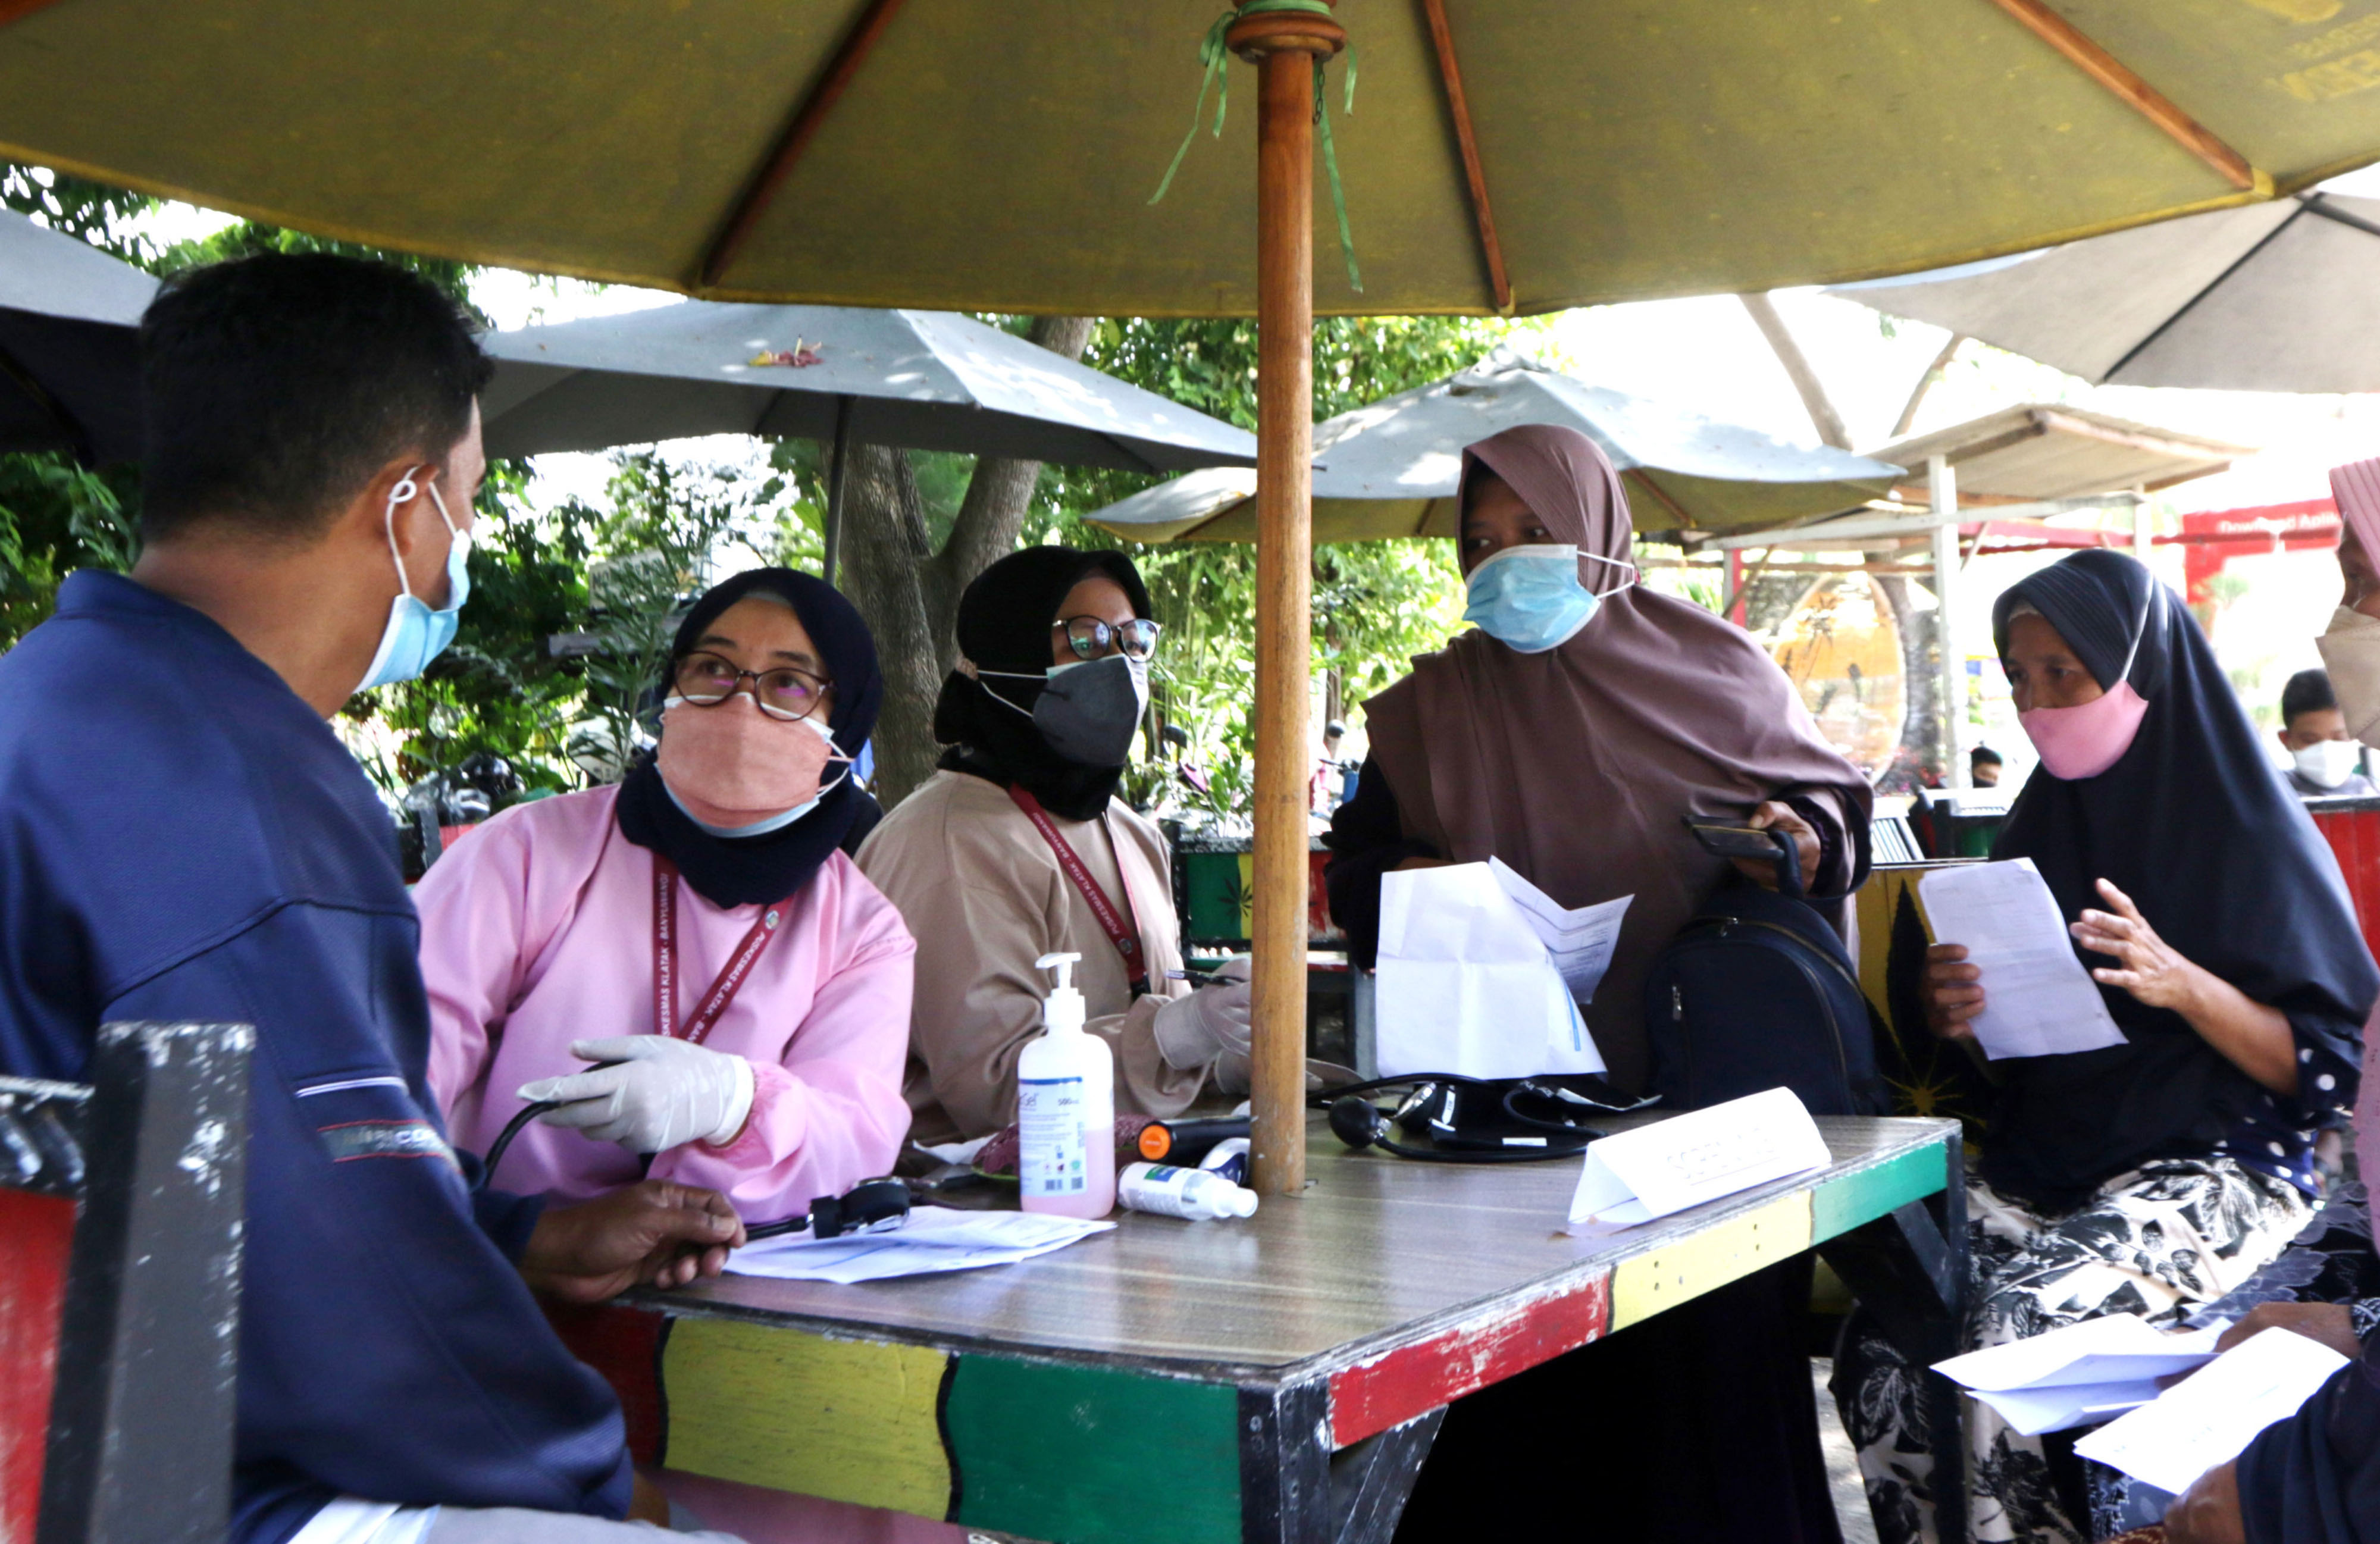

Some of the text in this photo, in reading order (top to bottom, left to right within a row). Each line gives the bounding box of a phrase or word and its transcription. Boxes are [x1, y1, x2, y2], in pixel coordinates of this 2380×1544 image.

[2300, 512, 2340, 529] Aplik
[1069, 862, 1092, 891] KLATAK
[1088, 890, 1120, 935] PUSKESMAS
[660, 947, 669, 986] KLATAK
[729, 931, 766, 982] PUSKESMAS
[660, 988, 671, 1036] SKESMAS
[704, 981, 733, 1016] KLATAK
